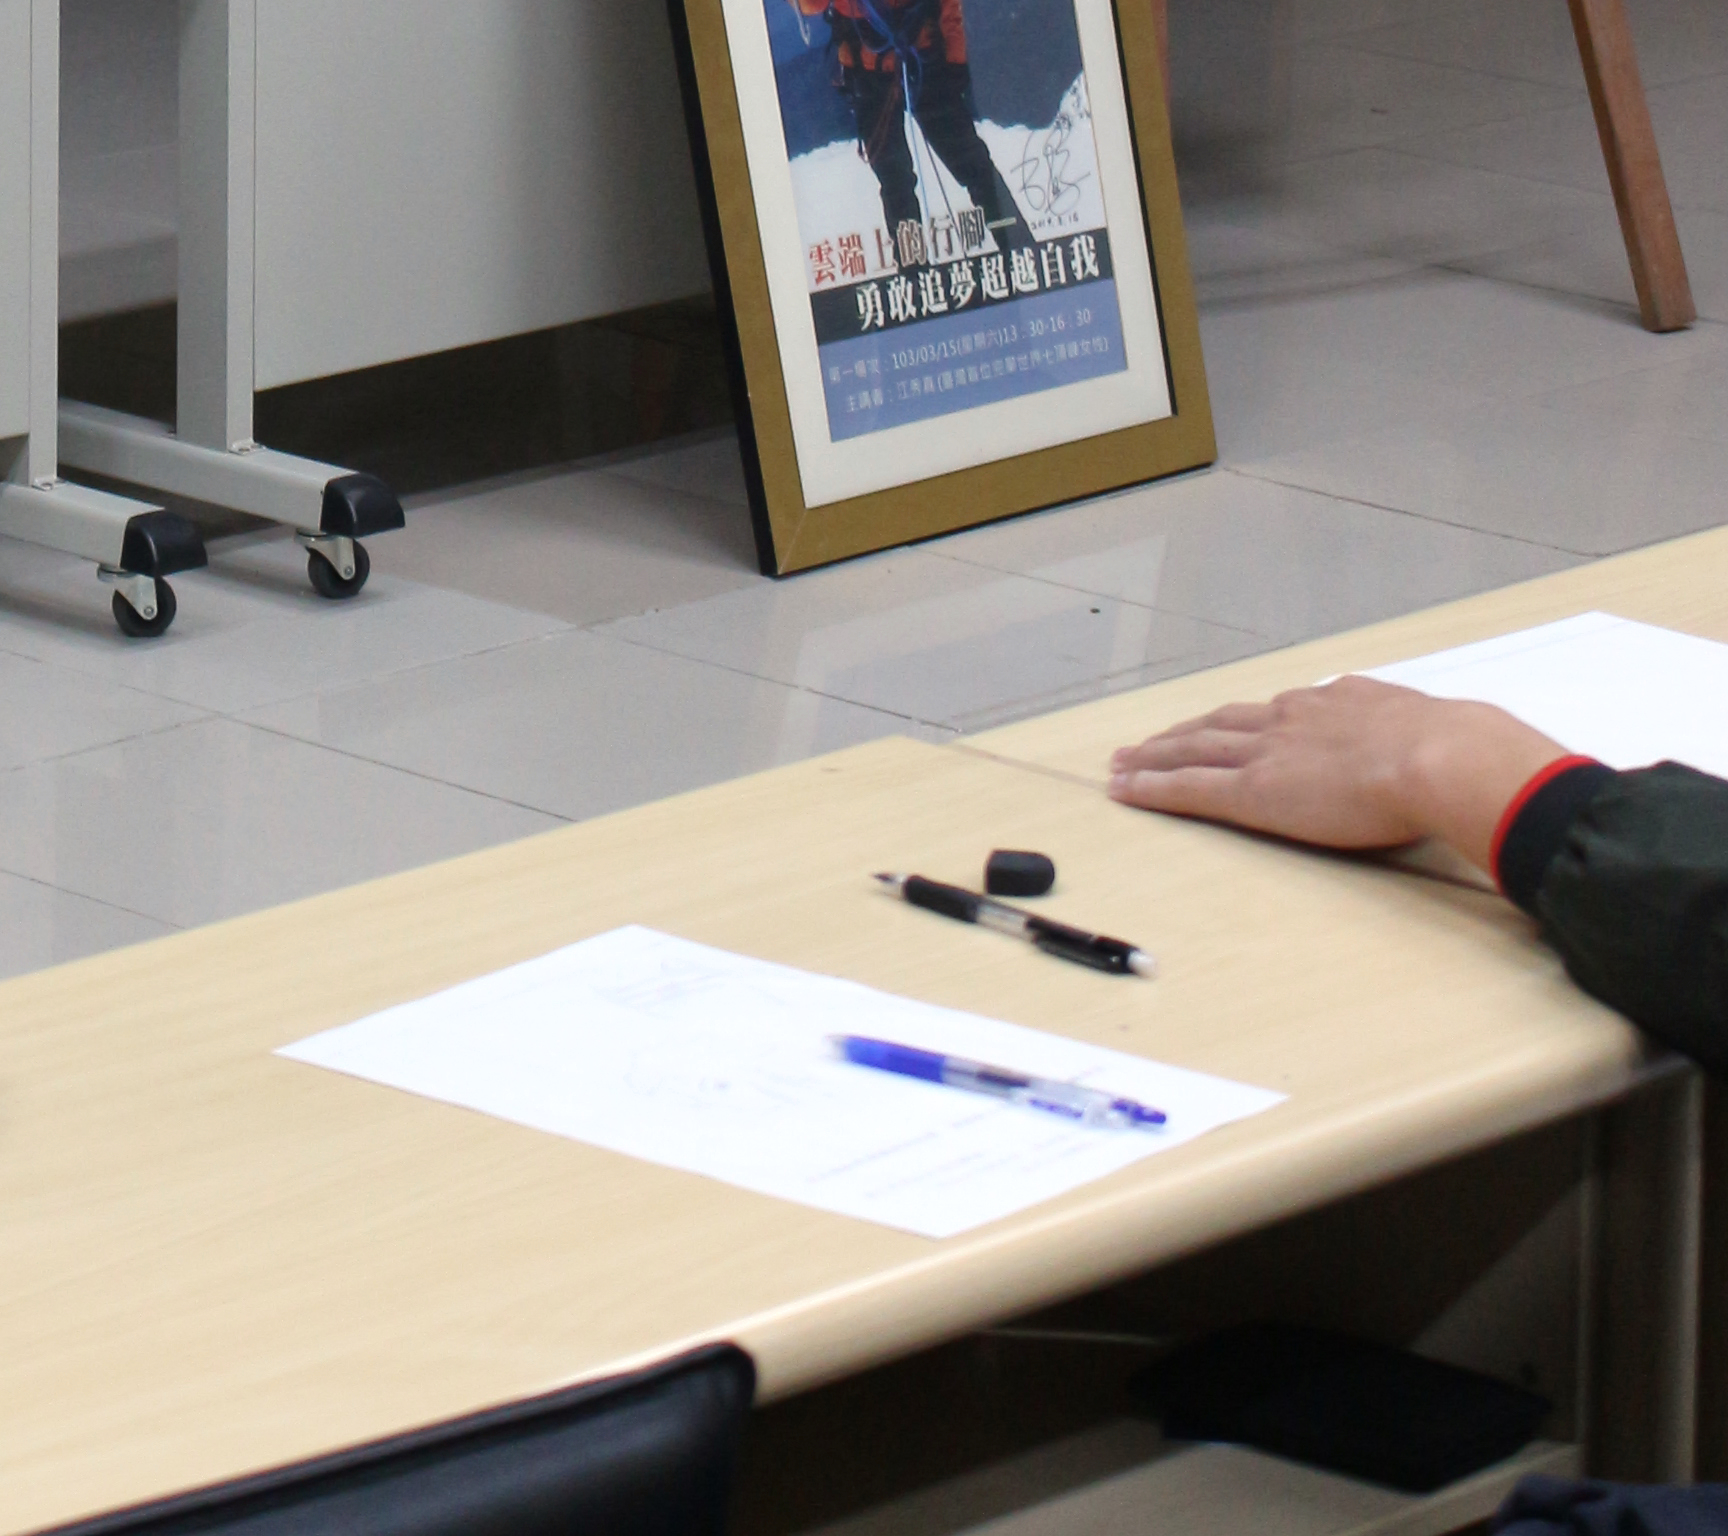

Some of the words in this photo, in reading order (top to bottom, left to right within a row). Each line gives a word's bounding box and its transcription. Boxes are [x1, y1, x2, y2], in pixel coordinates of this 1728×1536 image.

[857, 235, 1099, 331] 勇敢追夢超越自我
